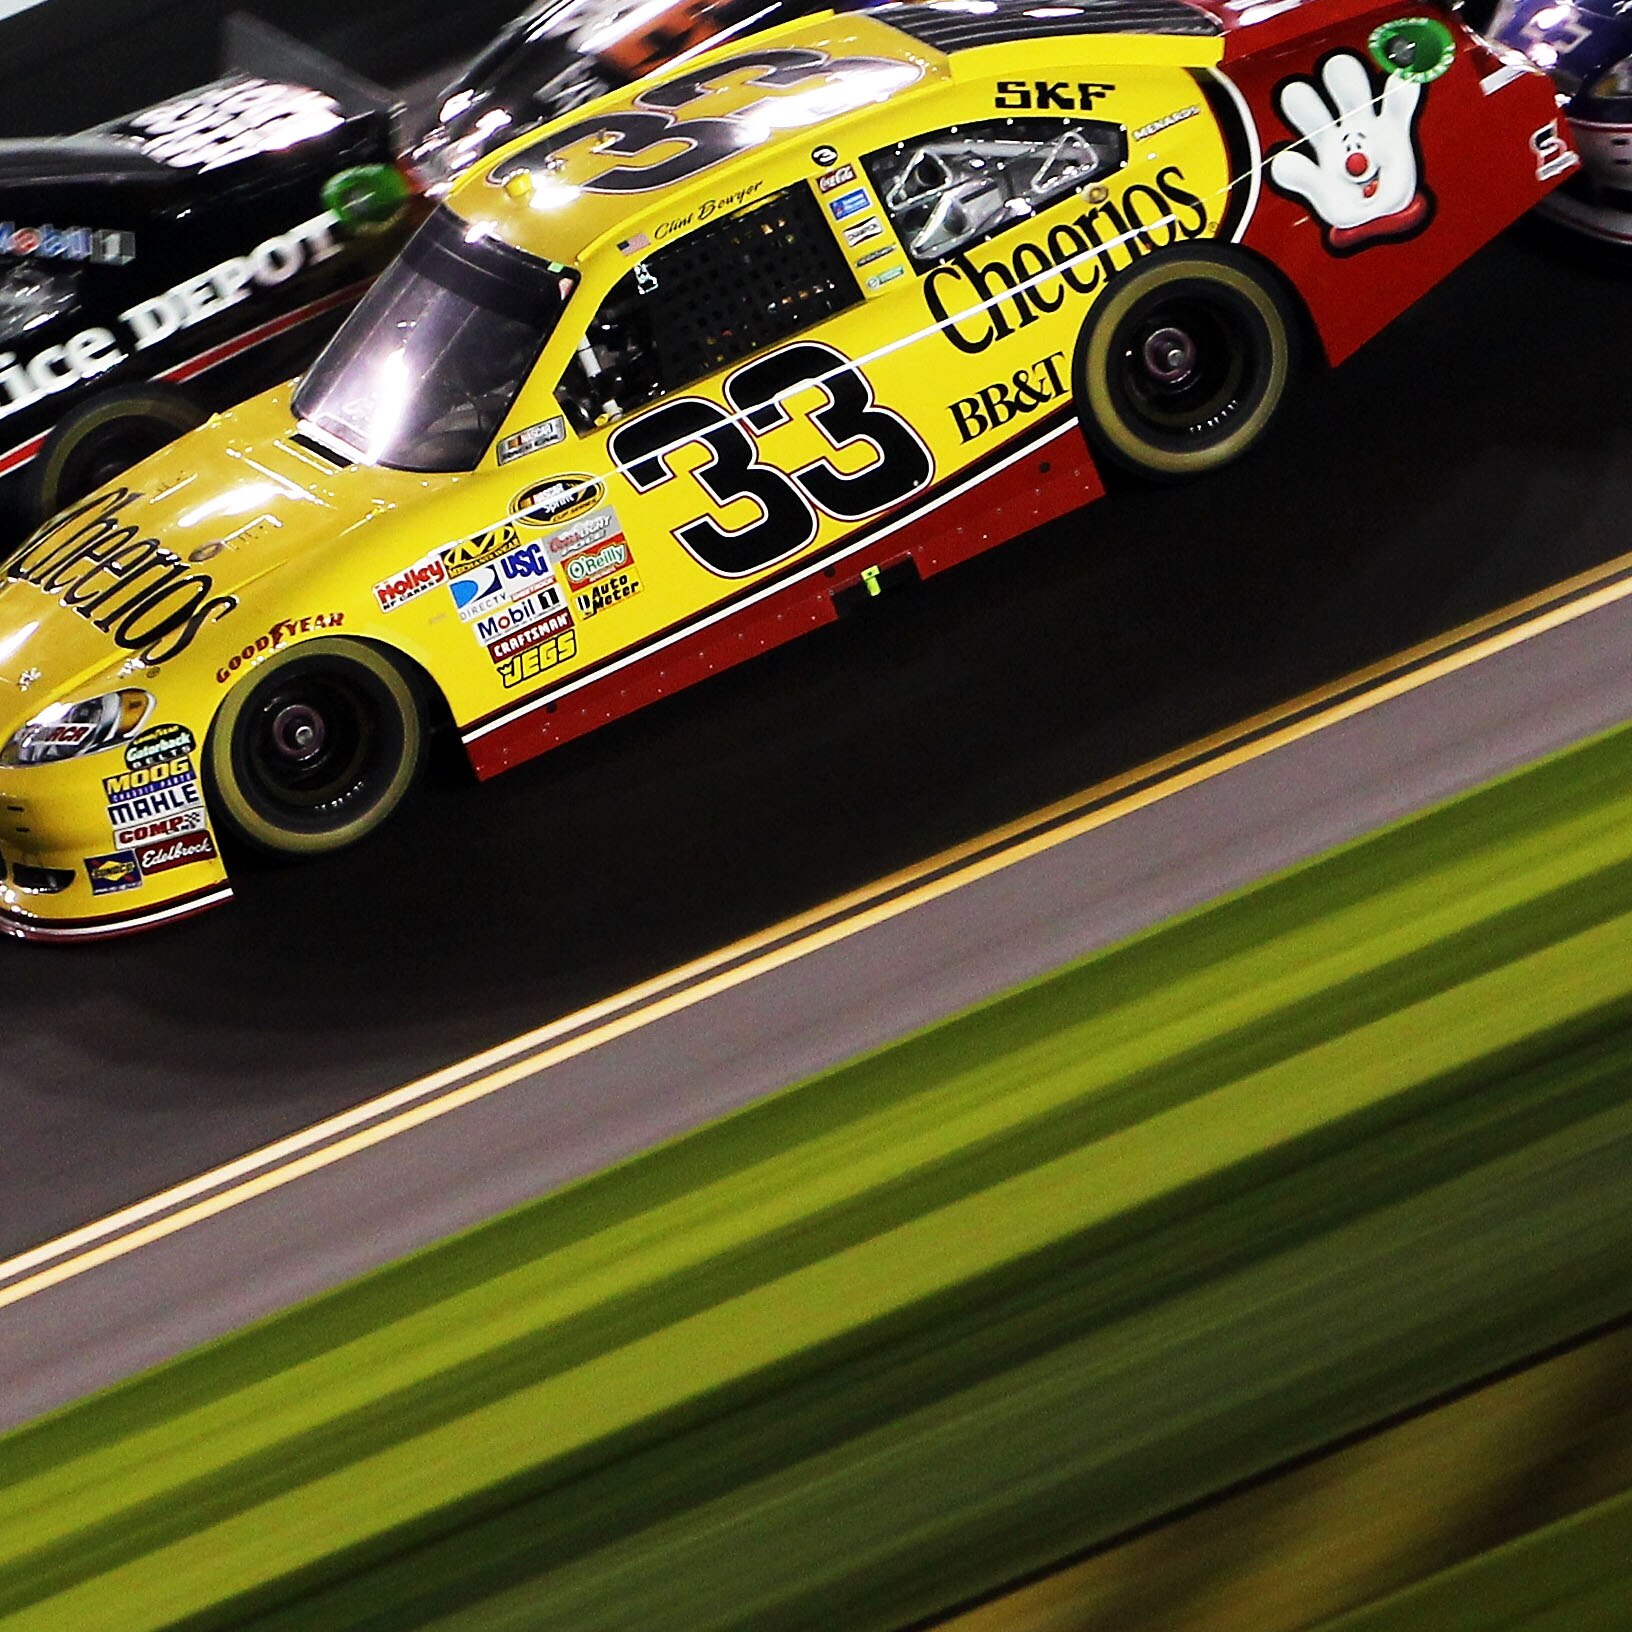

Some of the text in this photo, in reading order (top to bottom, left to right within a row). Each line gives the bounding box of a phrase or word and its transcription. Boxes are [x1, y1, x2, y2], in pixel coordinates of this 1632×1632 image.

[994, 80, 1116, 111] SKF
[486, 48, 927, 194] 33
[653, 179, 765, 241] Clint Bowyer
[95, 228, 136, 266] 1
[922, 164, 1210, 356] Cheerios
[117, 209, 347, 352] DEPOT
[948, 349, 1070, 447] BB&T
[608, 341, 936, 580] 33
[543, 491, 576, 514] Sprint
[376, 557, 446, 605] Holley
[500, 542, 549, 580] USG
[566, 542, 627, 581] O'Reilly
[589, 580, 640, 616] Meter
[591, 573, 629, 598] Auto
[477, 586, 560, 640] Mobil 1
[493, 611, 569, 658] CRAFTSMAN
[215, 612, 345, 685] GOODYEAR
[501, 628, 578, 689] JEGS
[126, 732, 192, 763] Gatorback
[107, 754, 190, 796] MOOG
[107, 783, 200, 826] MAHLE
[119, 815, 185, 845] COMP
[141, 837, 213, 869] Edelbrock
